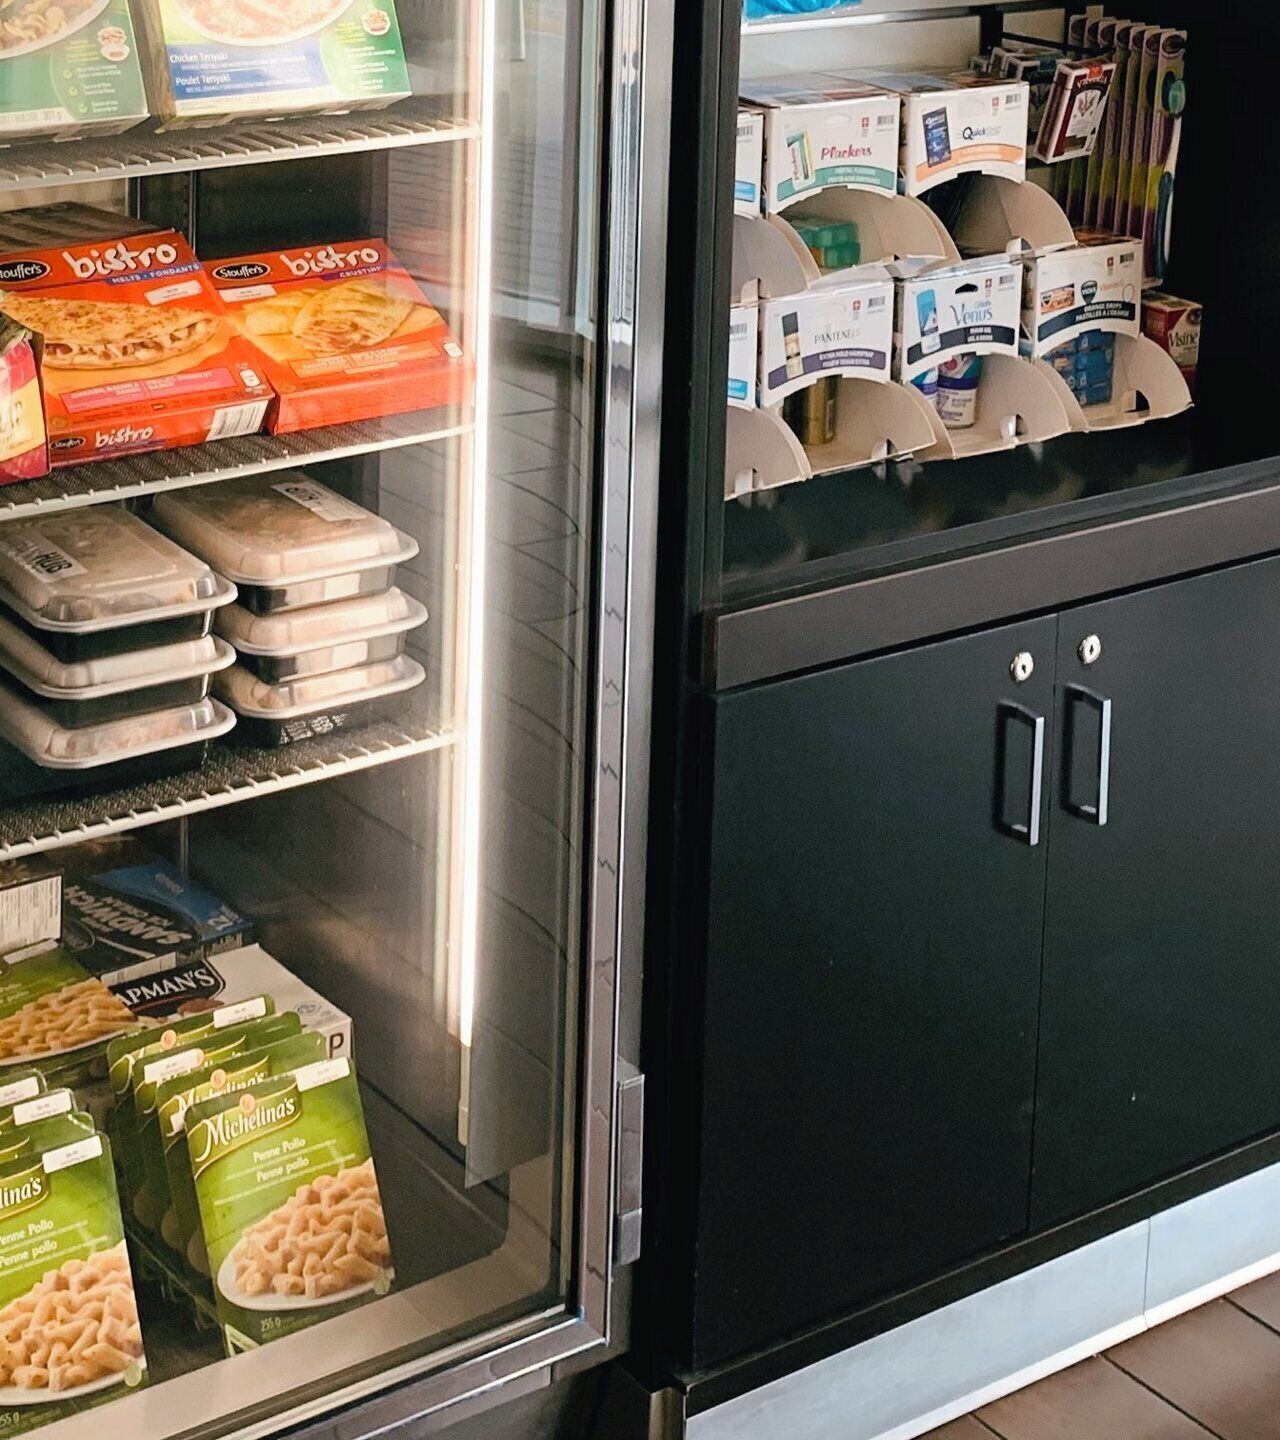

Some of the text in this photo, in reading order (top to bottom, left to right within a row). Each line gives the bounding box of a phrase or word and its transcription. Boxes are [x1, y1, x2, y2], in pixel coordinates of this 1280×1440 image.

[170, 51, 228, 63] Chicken Teriyaki
[175, 73, 231, 86] Poulet Teriyaki
[821, 145, 872, 160] Plackers
[62, 241, 177, 279] bistro
[279, 246, 380, 277] bistro
[112, 263, 201, 284] MELTS FONDANTS
[219, 264, 264, 278] Stouffer's
[950, 303, 993, 326] Venus
[1169, 331, 1198, 348] Visine
[95, 425, 154, 448] bistro
[195, 1097, 296, 1162] Michelina's
[253, 1138, 306, 1163] Penne Pollo
[256, 1157, 309, 1182] Penne pollo
[28, 1219, 54, 1236] Pollo
[32, 1240, 58, 1257] pollo
